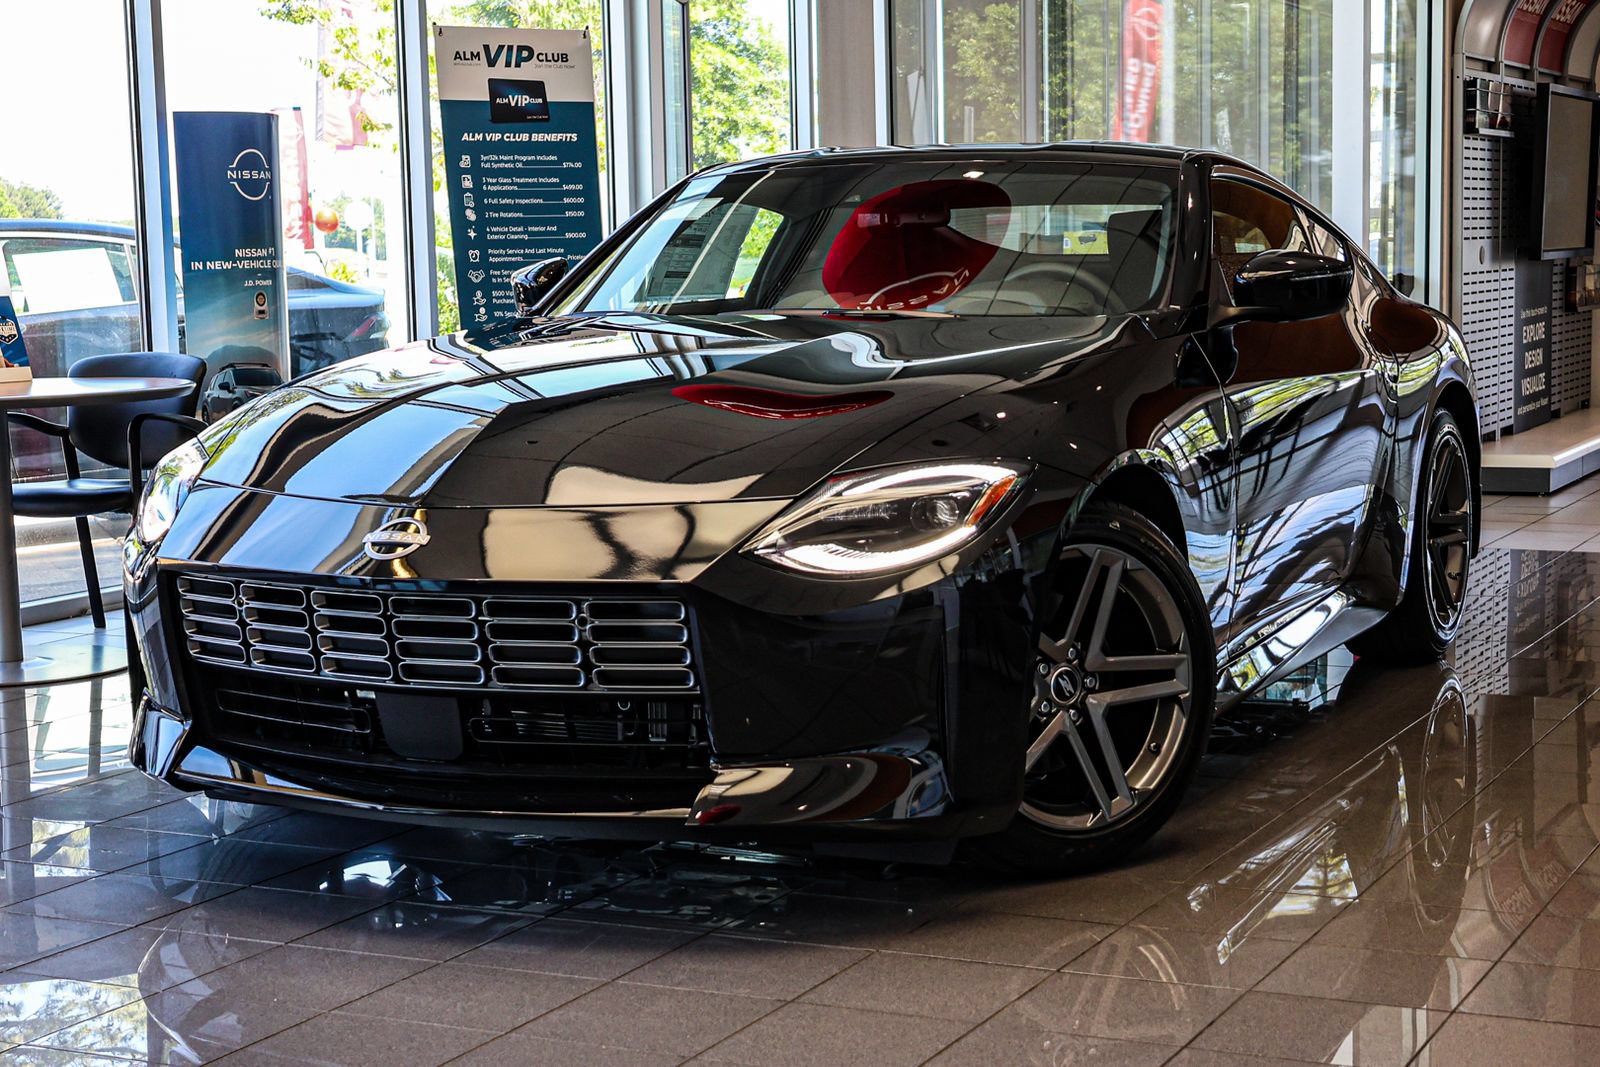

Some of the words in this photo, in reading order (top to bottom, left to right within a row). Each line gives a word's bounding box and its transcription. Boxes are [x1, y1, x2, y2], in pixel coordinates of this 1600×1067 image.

[453, 51, 480, 61] ALM
[482, 44, 534, 68] VIP
[536, 52, 569, 63] CLUB
[508, 95, 529, 107] VIP
[462, 133, 483, 141] ALM
[485, 133, 502, 141] VIP
[503, 133, 529, 141] CLUB
[531, 133, 578, 142] BENEFITS
[227, 170, 271, 179] NISSAN
[235, 248, 267, 257] NISSAN
[268, 247, 275, 256] #1
[191, 261, 203, 270] IN
[206, 260, 272, 270] NEW-VEHICLE
[1522, 321, 1545, 343] EXPLORE
[1524, 347, 1543, 369] DESIGN
[1521, 372, 1546, 396] VISUALIZE
[363, 530, 431, 546] NISSAN
